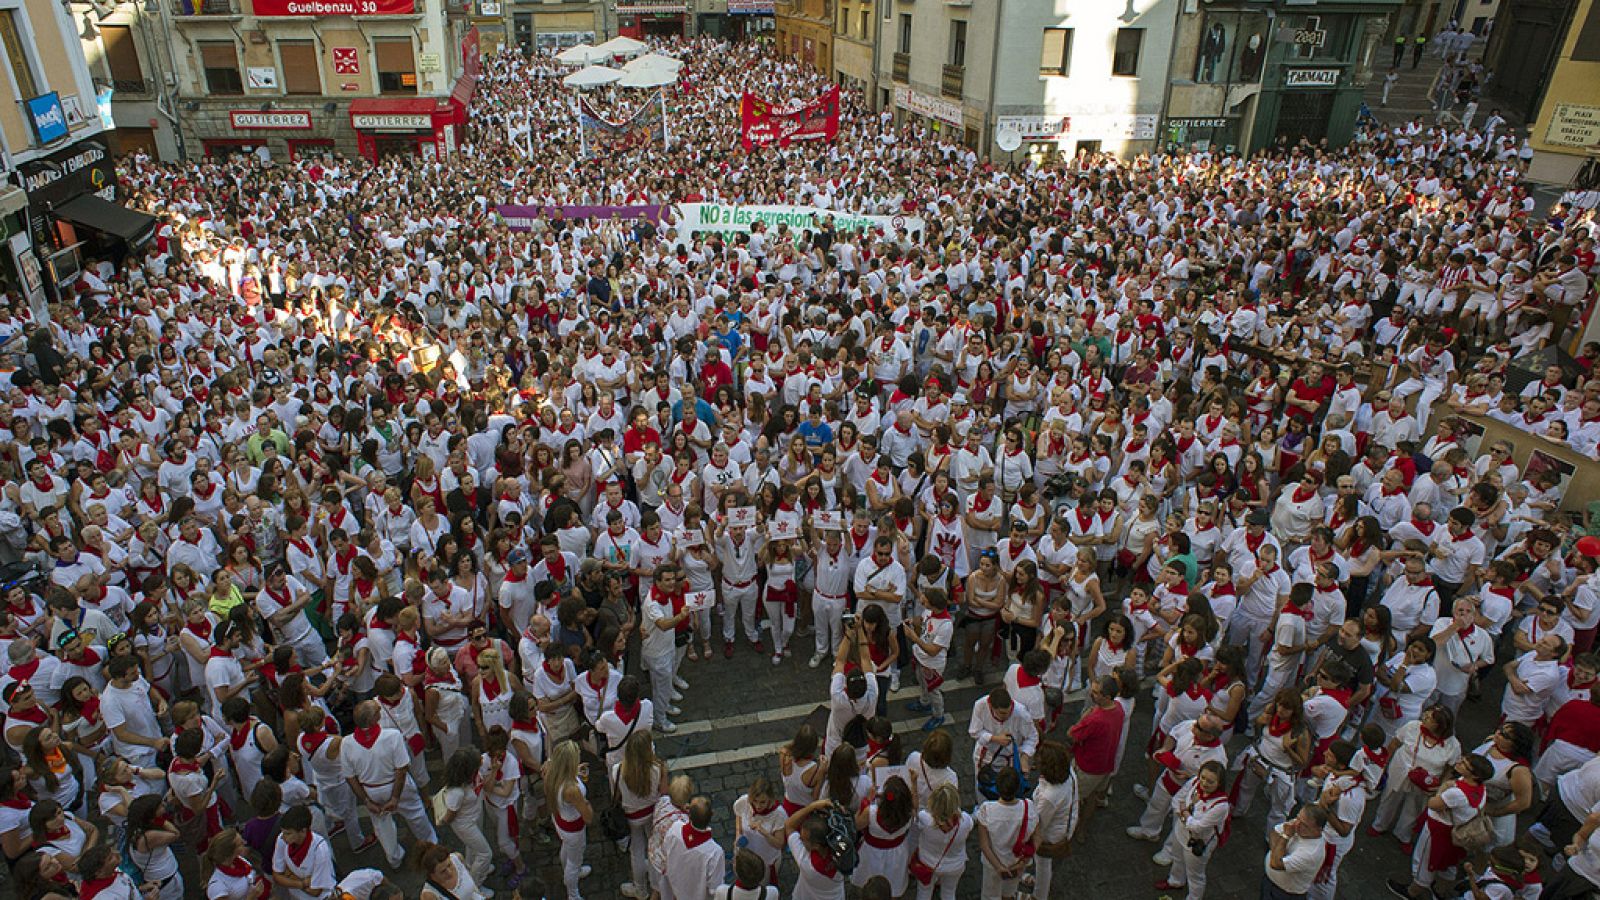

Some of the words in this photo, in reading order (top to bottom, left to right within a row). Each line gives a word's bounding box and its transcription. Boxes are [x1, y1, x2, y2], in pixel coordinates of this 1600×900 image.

[288, 1, 357, 14] Guelbenzu,
[361, 1, 377, 13] 30
[1288, 71, 1335, 84] FARMACIA
[237, 113, 305, 125] GUTIERREZ
[359, 115, 427, 126] GUTIERREZ
[1169, 119, 1226, 127] GUTIERREZ
[700, 204, 720, 225] NO
[722, 208, 732, 224] a
[733, 205, 752, 223] las
